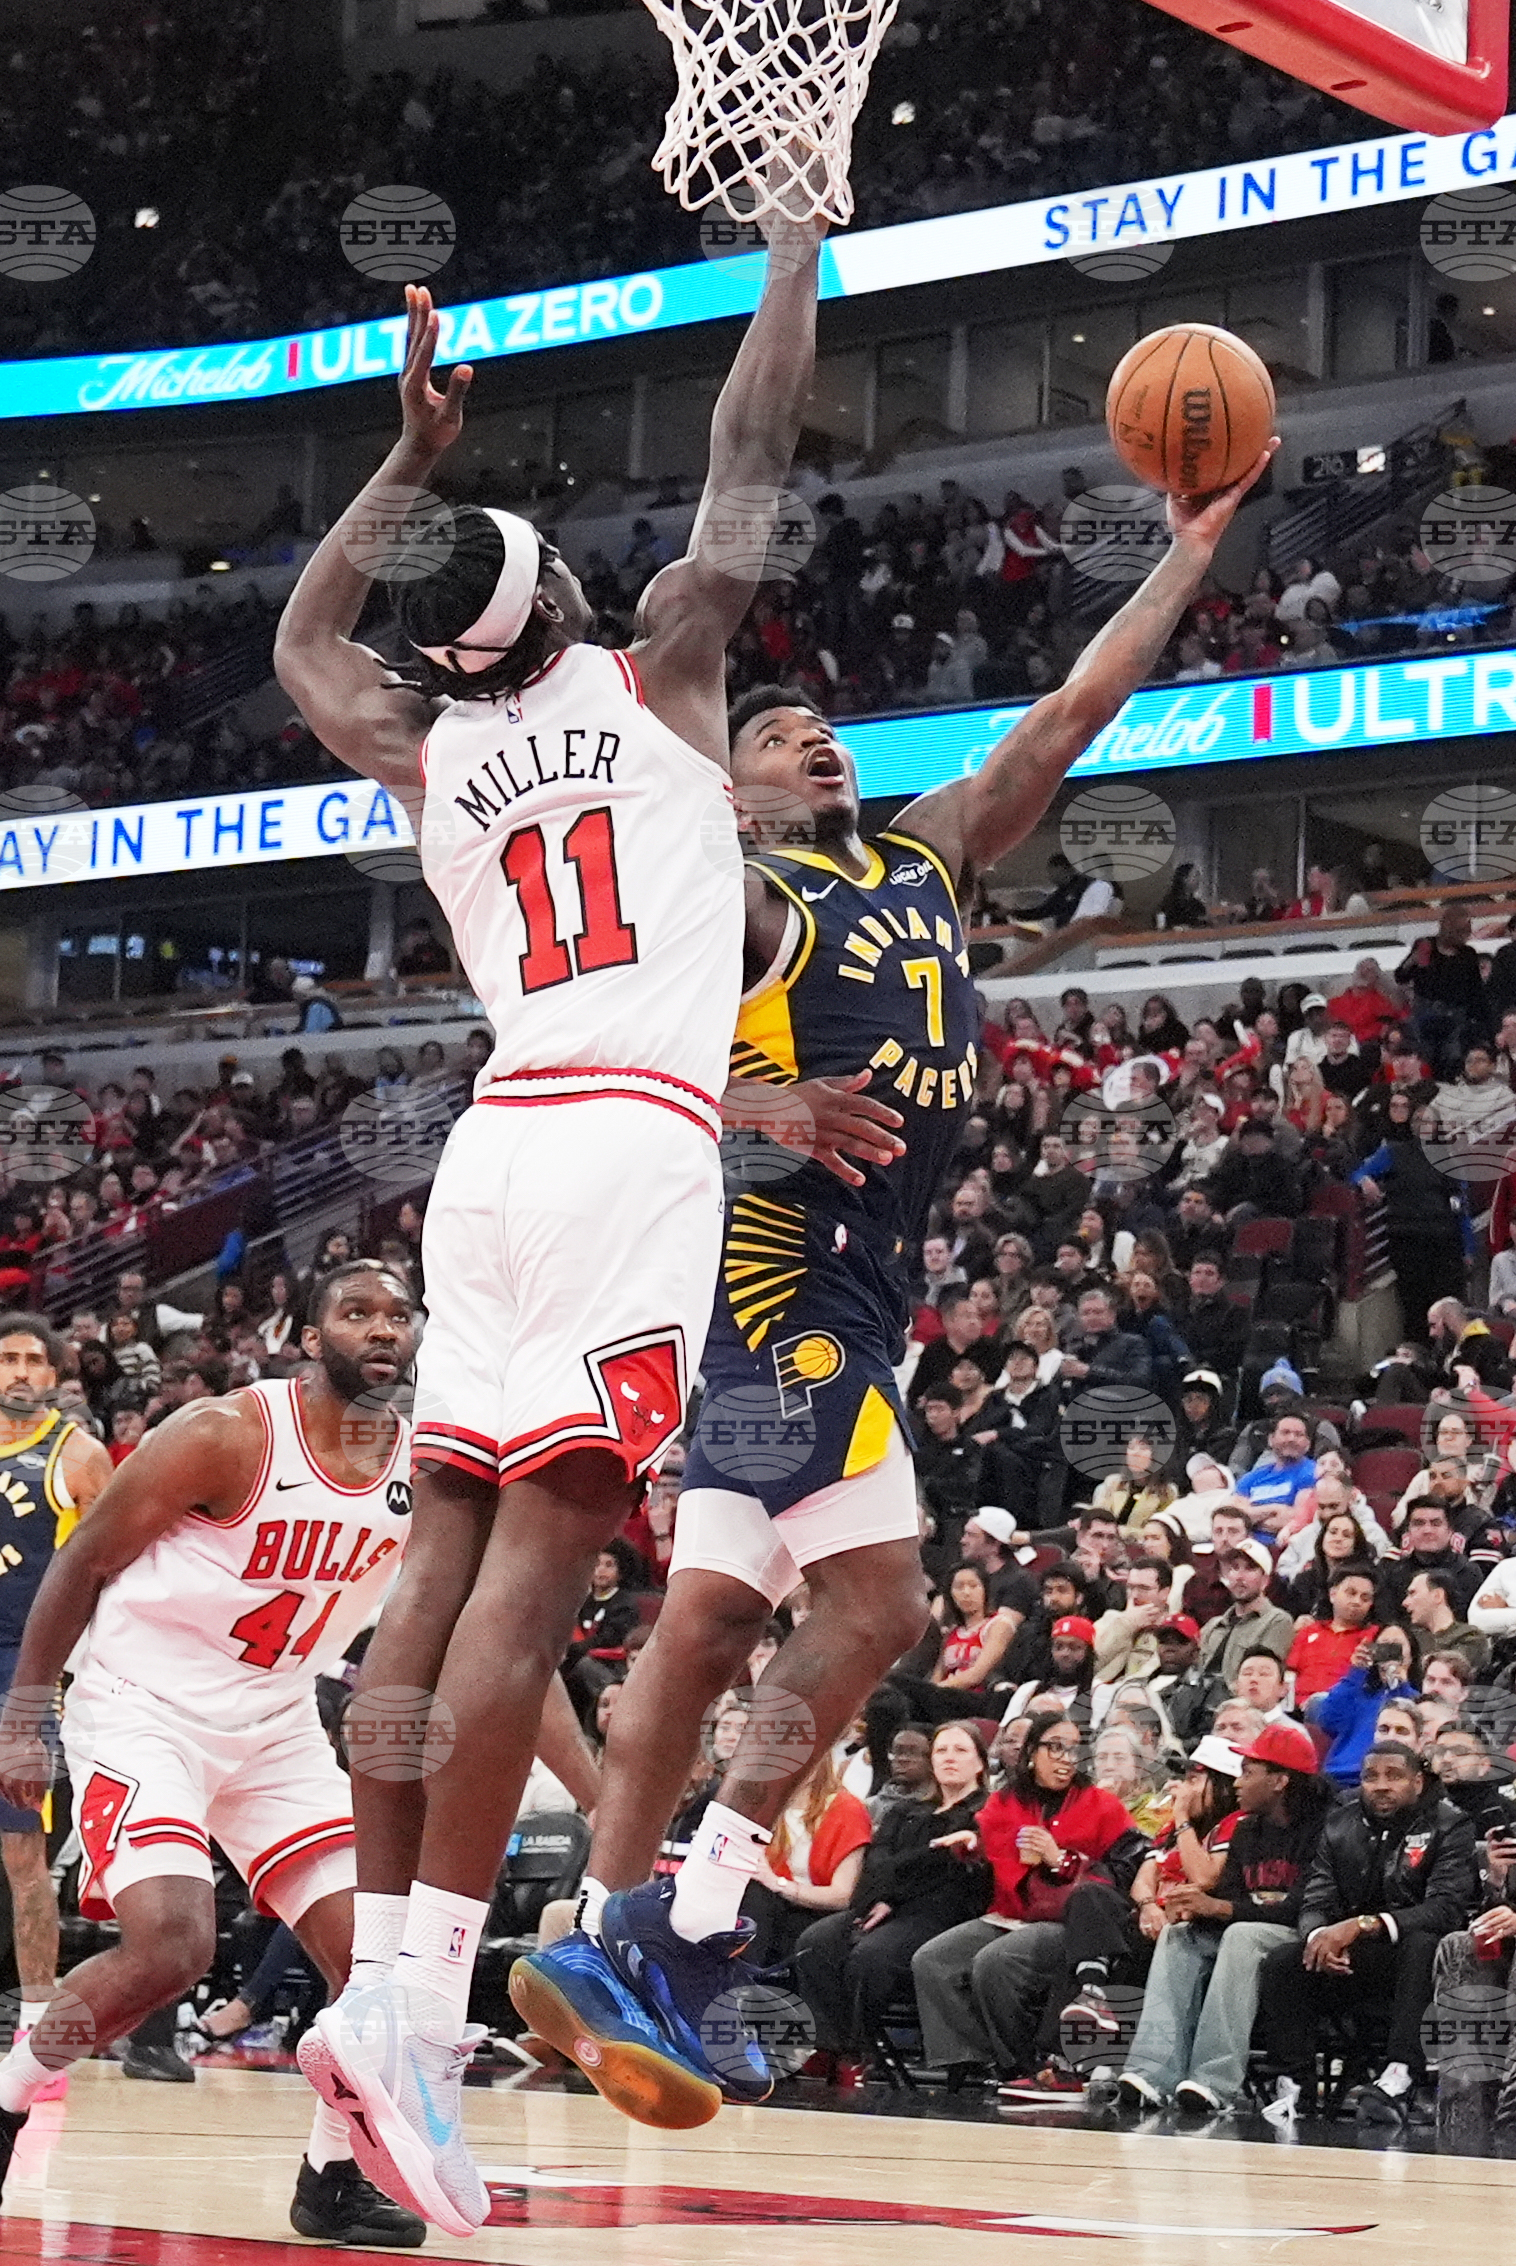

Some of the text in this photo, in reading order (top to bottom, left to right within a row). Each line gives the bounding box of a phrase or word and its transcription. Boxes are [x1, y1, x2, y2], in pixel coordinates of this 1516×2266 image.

[1043, 129, 1516, 249] STAY IN THE G
[77, 342, 277, 411] Michelob
[503, 273, 664, 348] ZERO
[1293, 655, 1516, 744] ULTR
[454, 729, 620, 832] MILLER
[90, 814, 145, 869] IN
[176, 799, 285, 859] THE
[316, 787, 398, 844] GA
[889, 860, 934, 885] LUCAS OIL
[499, 805, 639, 997] 11
[900, 955, 946, 1048] 7
[241, 1519, 399, 1583] BULLS
